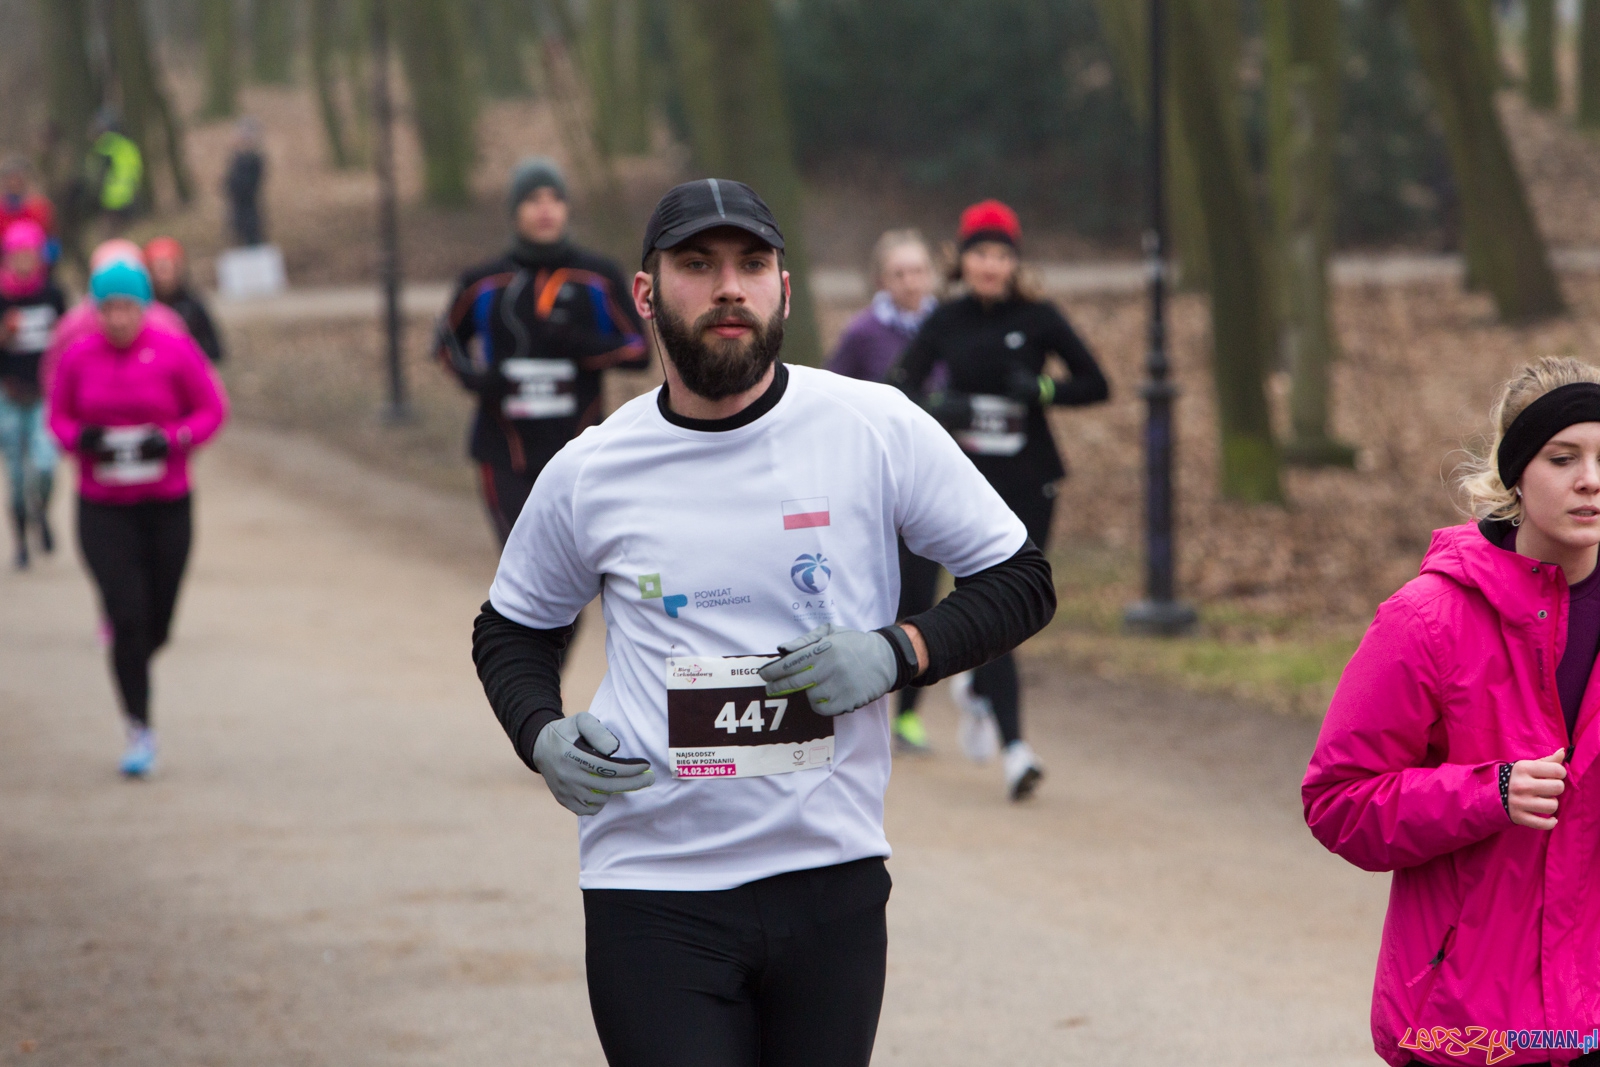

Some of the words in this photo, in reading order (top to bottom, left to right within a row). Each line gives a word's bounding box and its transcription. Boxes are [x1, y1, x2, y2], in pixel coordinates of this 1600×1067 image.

[694, 587, 732, 599] POWIAT
[695, 595, 751, 609] POZNAŃSKI
[714, 699, 788, 734] 447
[564, 750, 596, 770] Kalenji
[675, 751, 716, 759] NAJSŁODSZY
[677, 766, 726, 776] 14.02.2016
